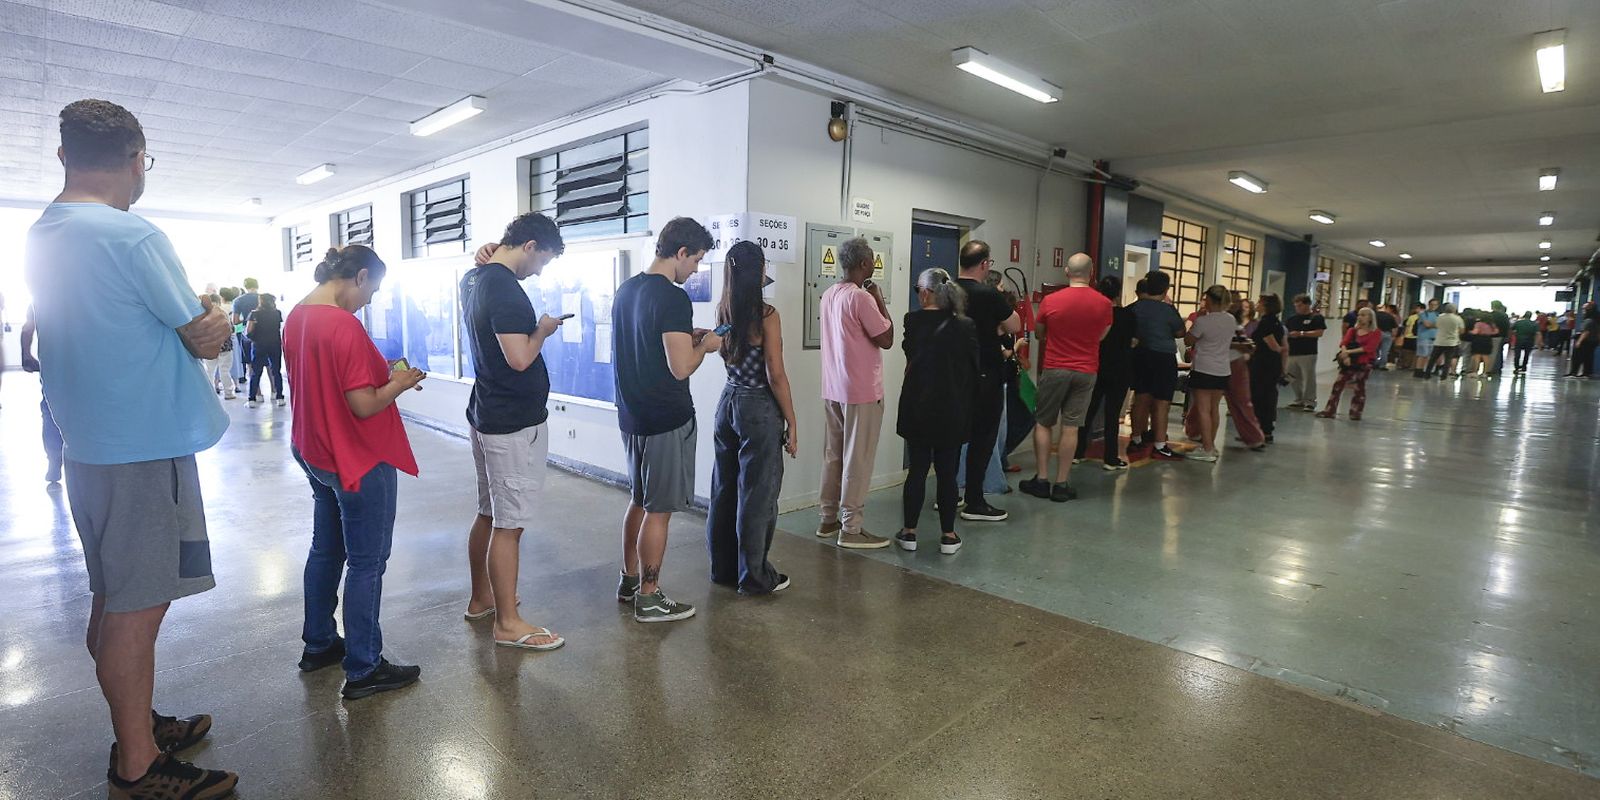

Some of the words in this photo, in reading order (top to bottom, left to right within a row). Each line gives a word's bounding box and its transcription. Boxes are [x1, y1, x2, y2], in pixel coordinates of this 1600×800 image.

[759, 219, 788, 230] SEÇÕES
[757, 237, 768, 249] 30
[770, 240, 776, 249] a
[778, 239, 789, 250] 36
